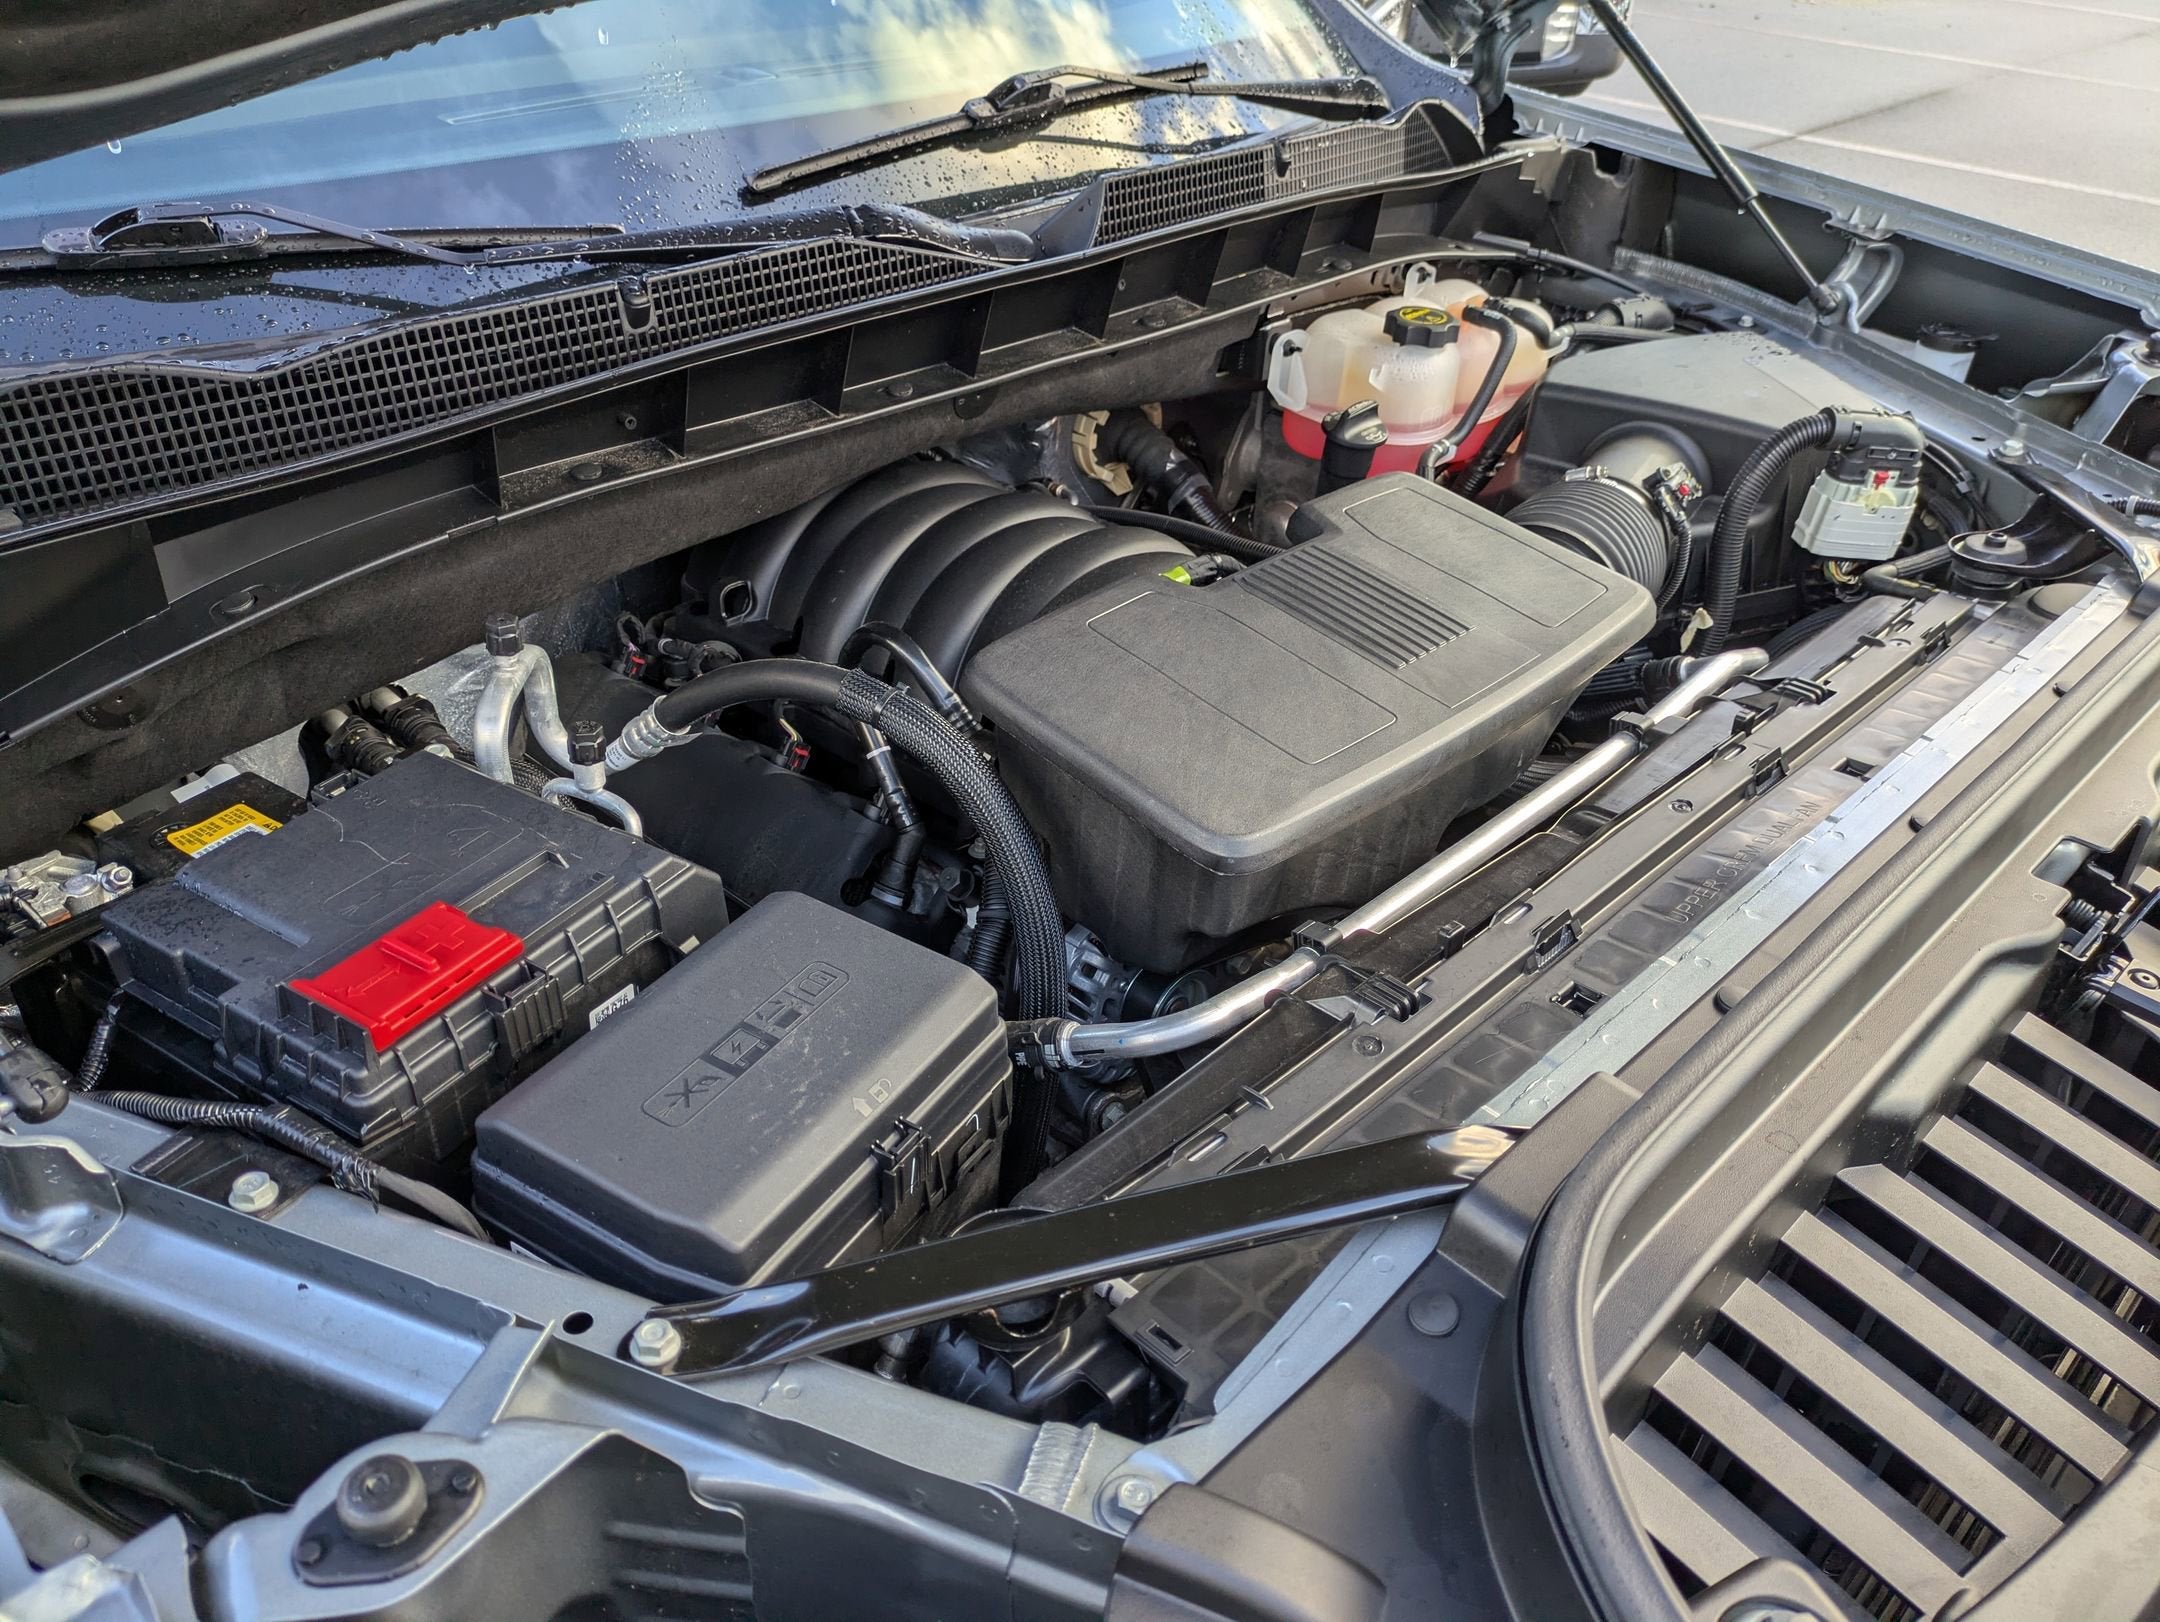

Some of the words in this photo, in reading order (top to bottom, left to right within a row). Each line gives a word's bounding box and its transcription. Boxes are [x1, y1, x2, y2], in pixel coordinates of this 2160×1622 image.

[1664, 879, 1727, 924] UPPER
[1751, 817, 1800, 846] DUAL
[1793, 801, 1823, 823] FAN
